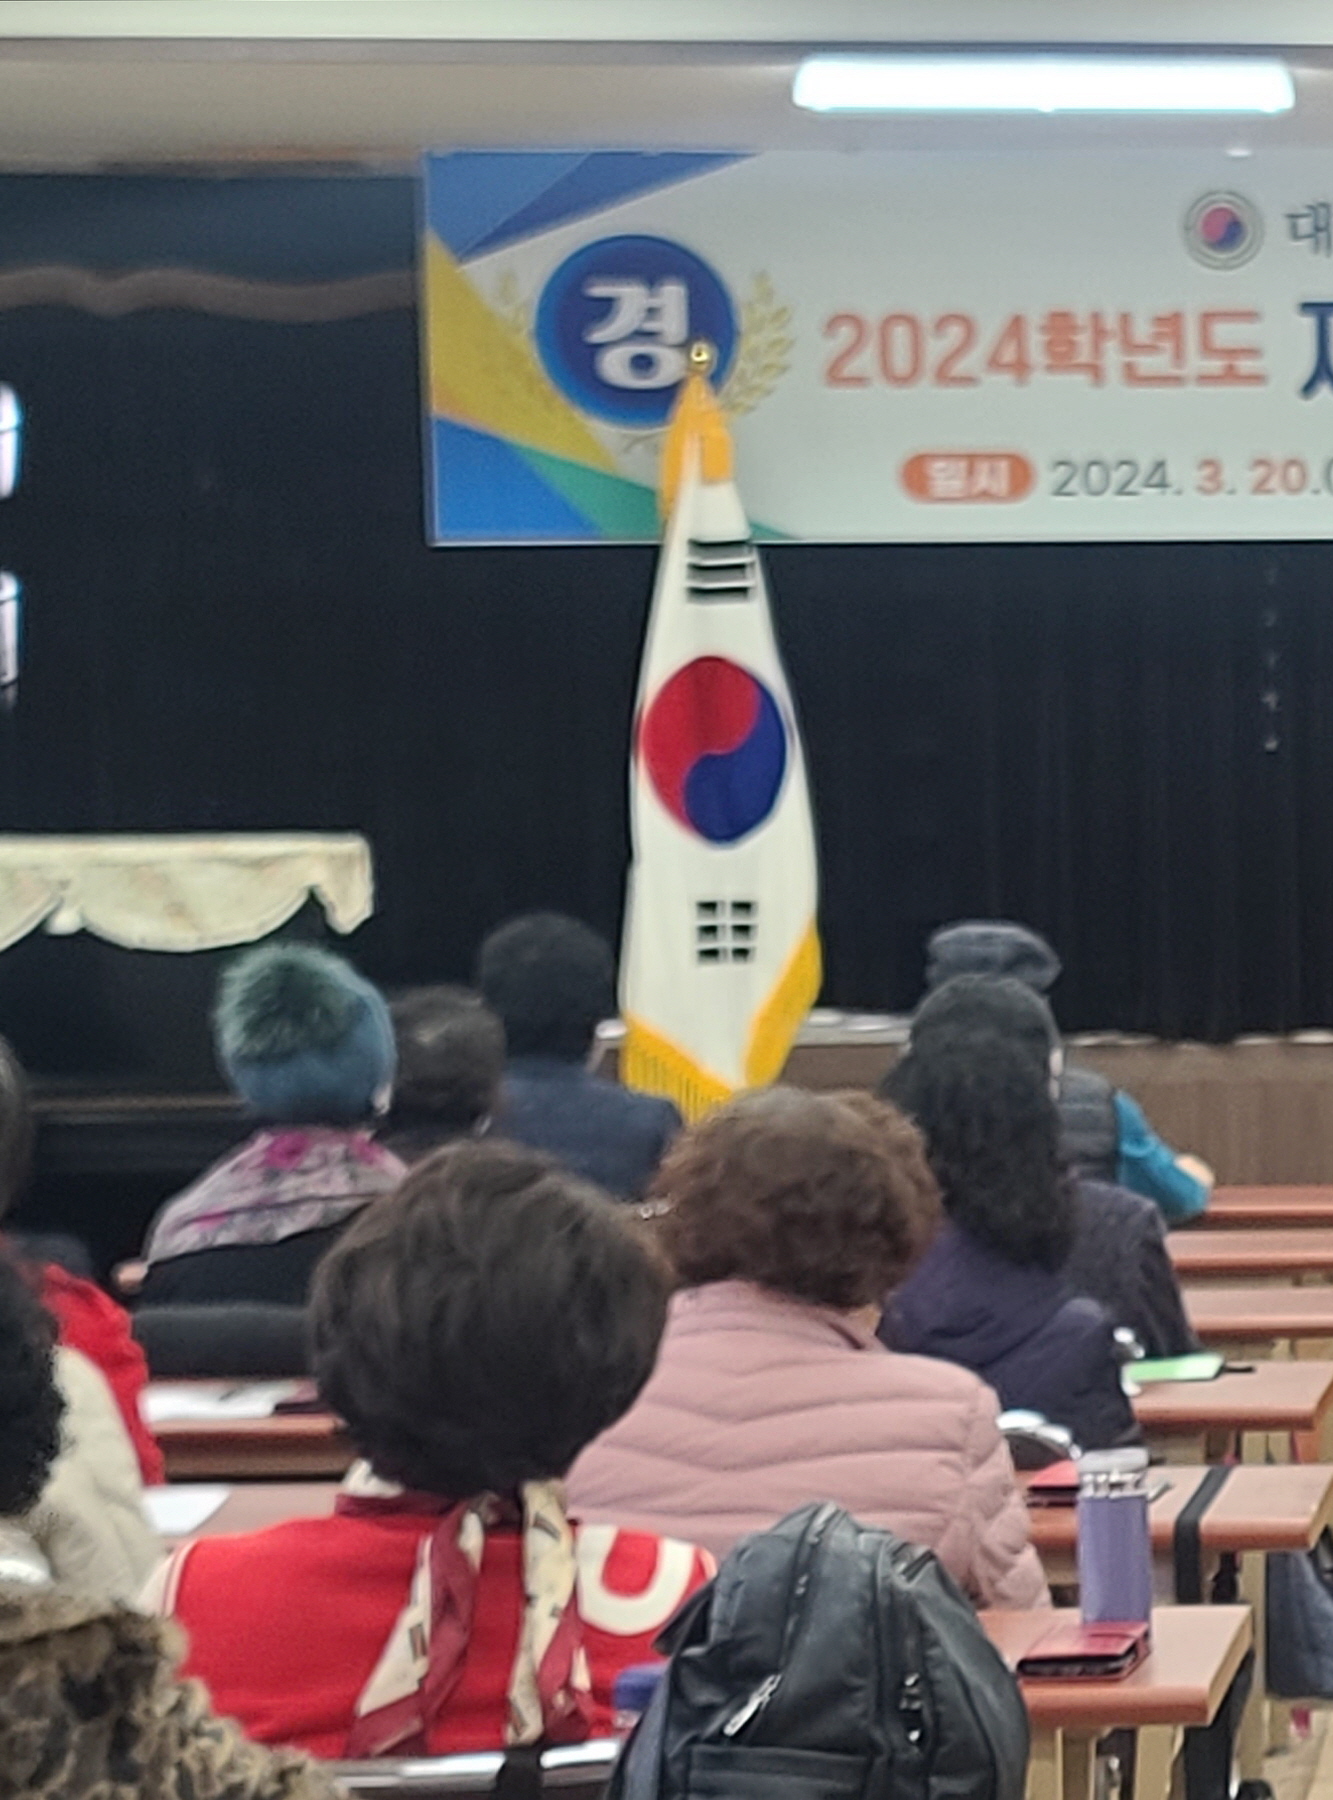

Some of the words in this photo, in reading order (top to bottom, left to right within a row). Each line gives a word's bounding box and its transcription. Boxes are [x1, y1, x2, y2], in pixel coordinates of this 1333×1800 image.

[583, 280, 689, 390] 경
[822, 308, 1268, 389] 2024학년도
[1050, 459, 1183, 498] 2024.
